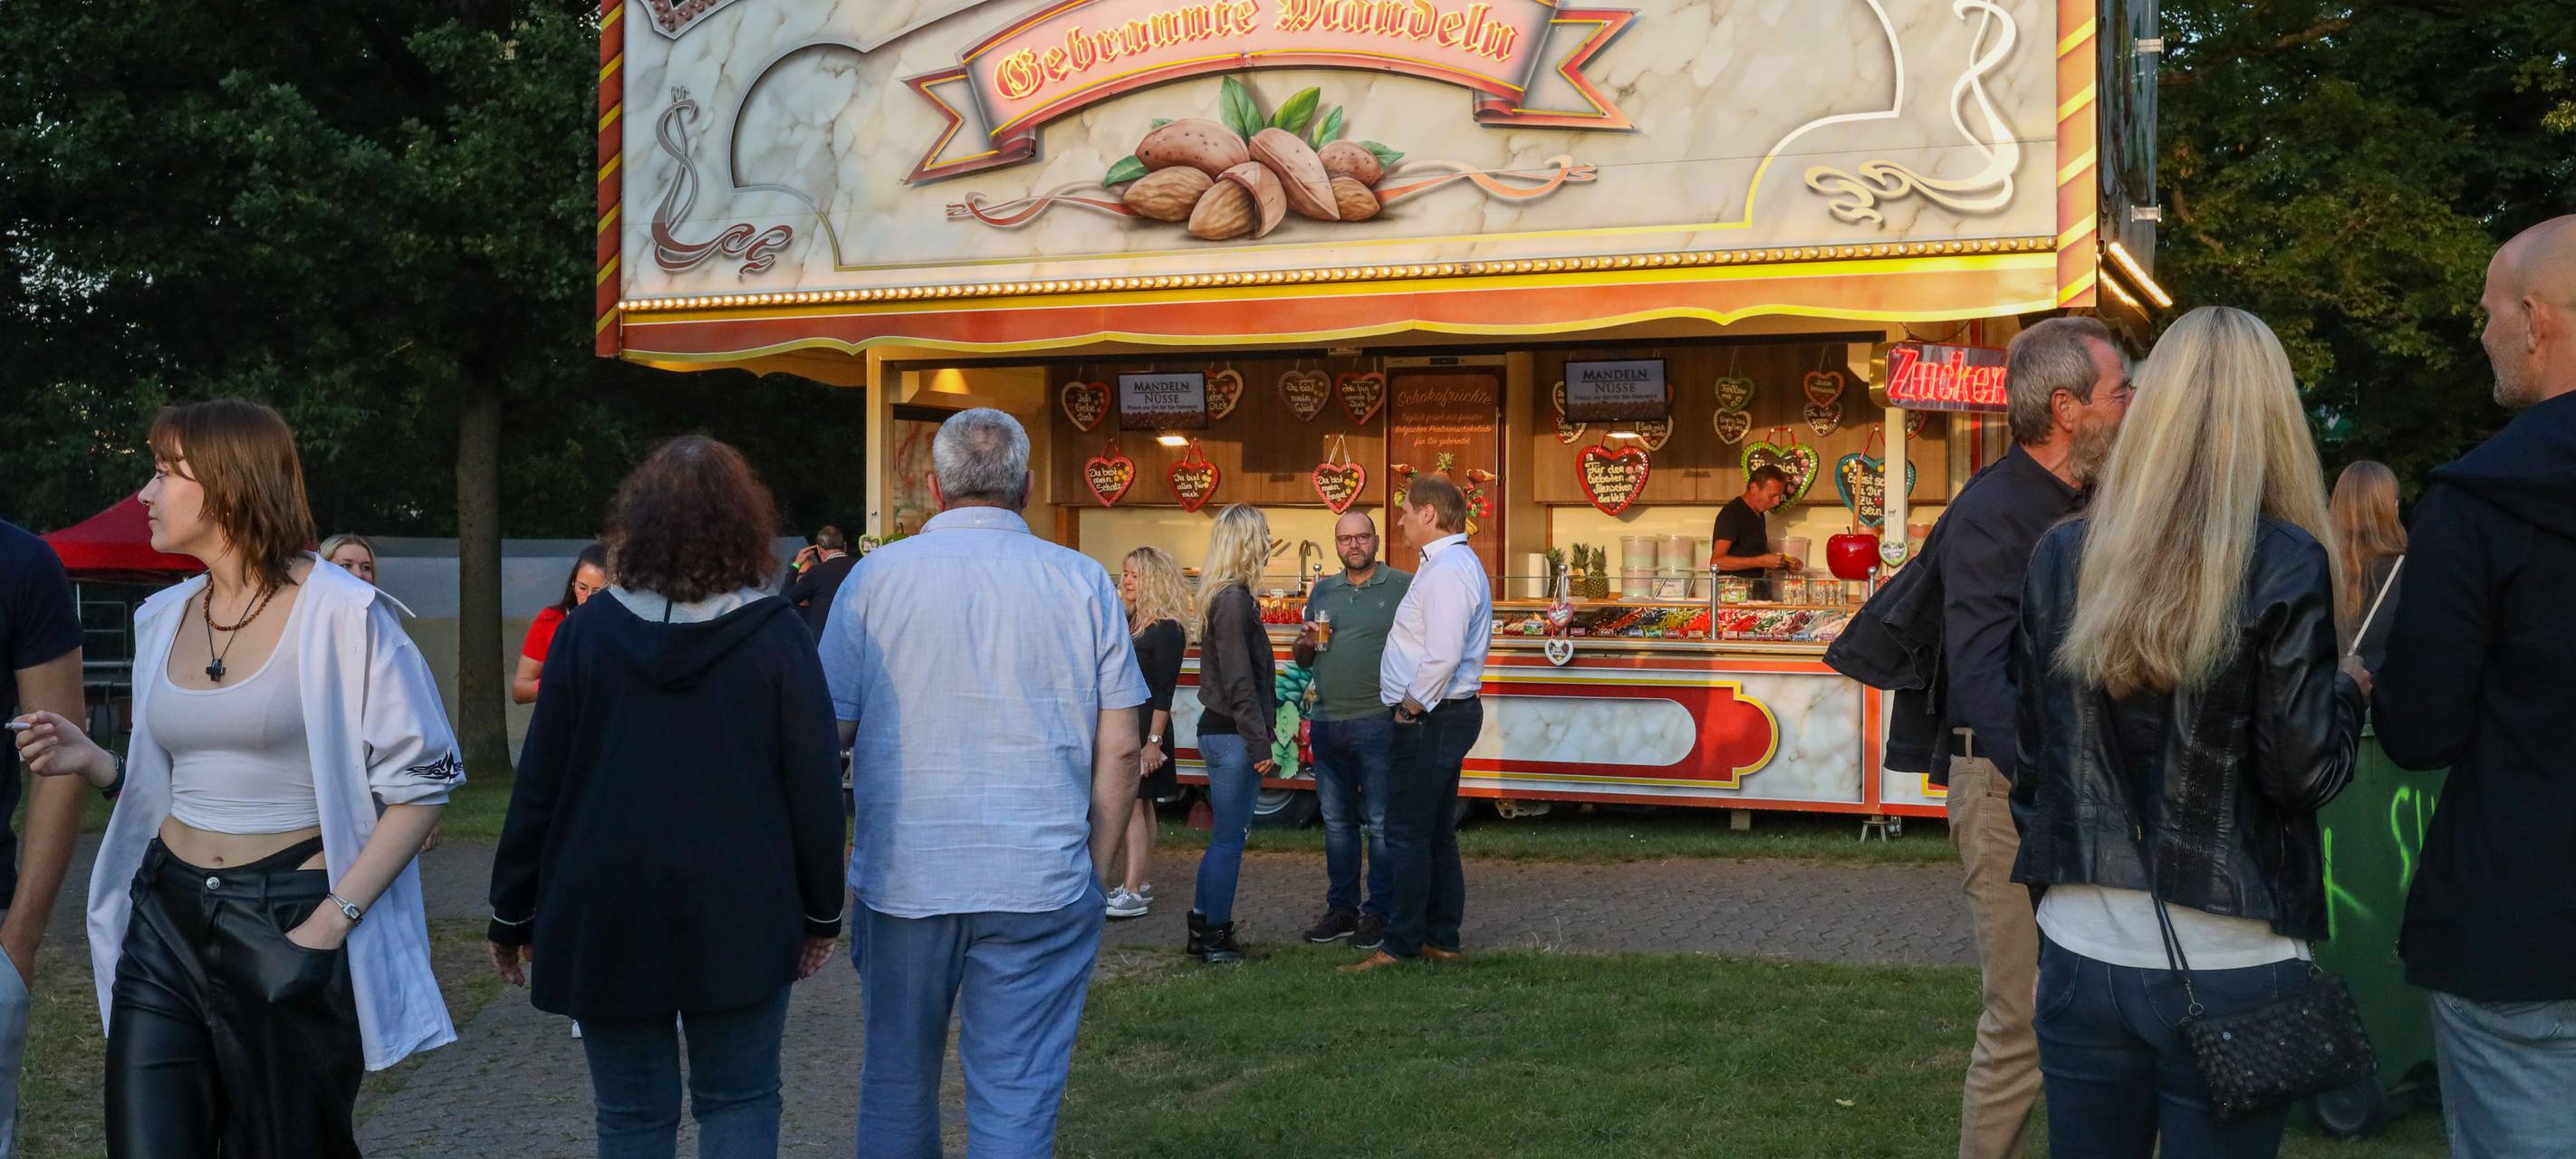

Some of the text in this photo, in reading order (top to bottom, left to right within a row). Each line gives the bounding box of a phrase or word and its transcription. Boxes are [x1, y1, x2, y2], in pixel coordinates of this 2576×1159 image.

[993, 0, 1519, 100] Gebrannte Mandeln
[1582, 369, 1648, 380] MANDELN
[1134, 381, 1190, 391] MANDELN
[1595, 381, 1637, 394] NÜSSE
[1144, 392, 1180, 404] NÜSSE
[1089, 468, 1101, 477] Du
[1584, 461, 1625, 474] Für den
[1093, 476, 1113, 484] mein
[1174, 473, 1201, 483] Du bist
[1317, 475, 1330, 484] Du
[1096, 483, 1122, 493] Schatz
[1177, 482, 1193, 491] alles
[1321, 484, 1341, 493] mein
[1592, 482, 1633, 493] Menschen
[1866, 485, 1883, 497] Dir
[1181, 490, 1199, 498] mich
[1326, 490, 1347, 502] Engel
[1859, 495, 1873, 506] zu
[1860, 503, 1883, 516] sein
